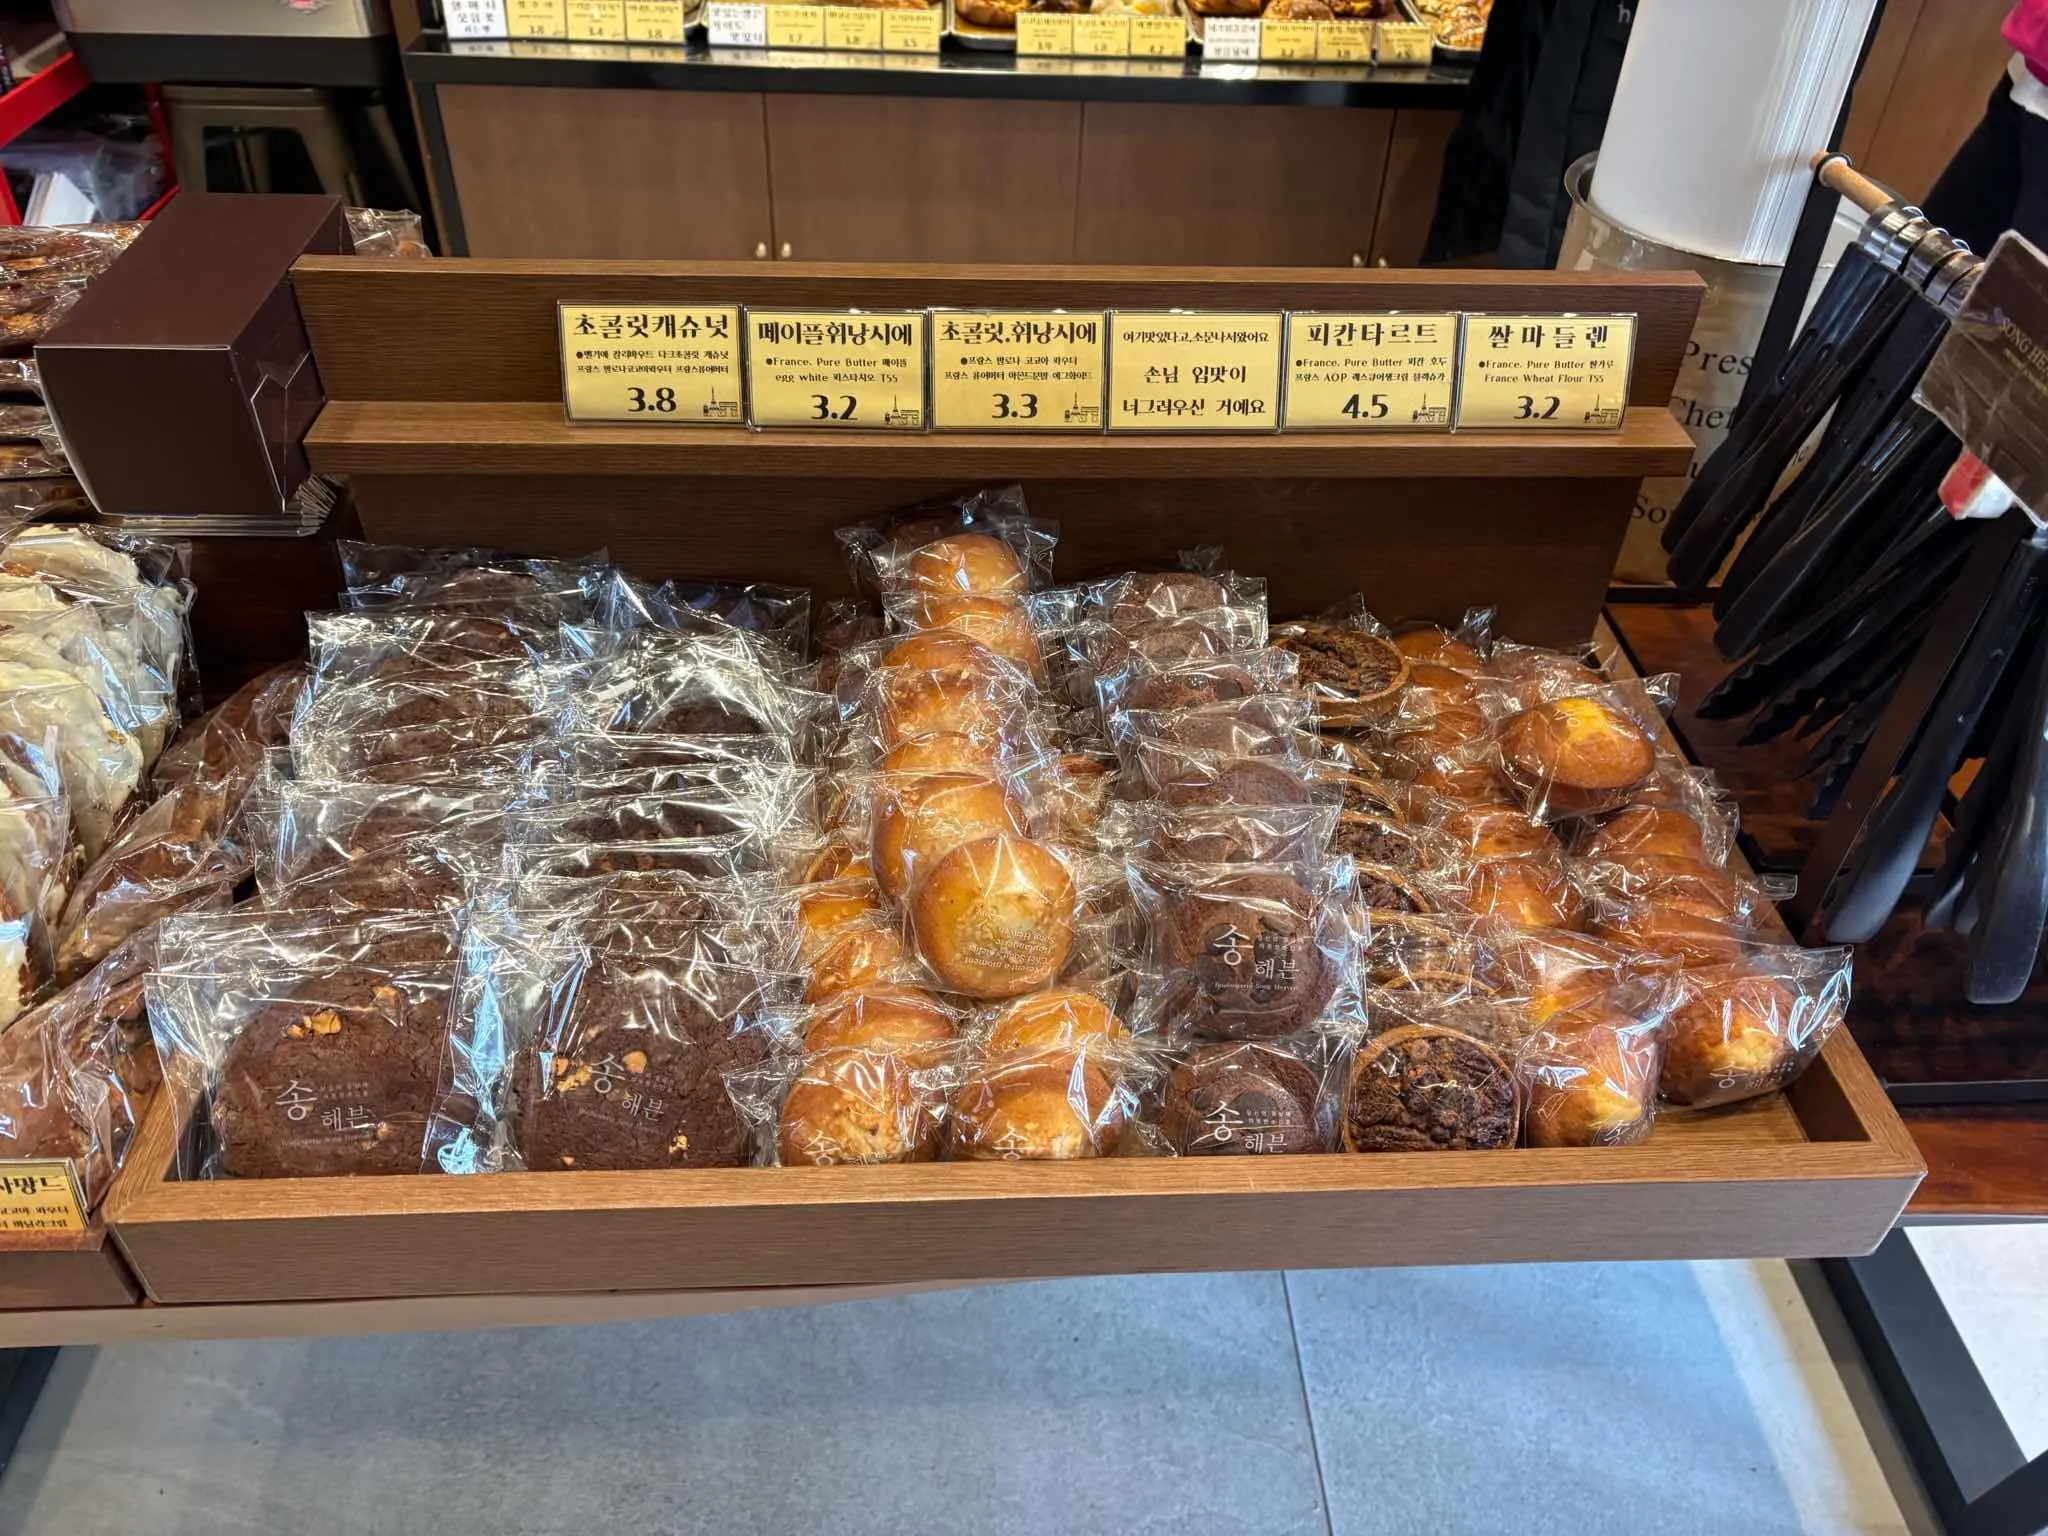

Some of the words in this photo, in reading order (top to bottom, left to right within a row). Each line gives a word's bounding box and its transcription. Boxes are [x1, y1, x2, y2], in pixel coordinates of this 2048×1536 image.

[573, 313, 729, 339] 초콜릿캐슈넛
[757, 321, 913, 346] 메이플휘낭시에
[939, 320, 1097, 345] 초콜릿.휘낭시에
[1307, 322, 1438, 347] 피칸타르트
[816, 357, 841, 367] Pure
[845, 357, 878, 367] Butter
[1024, 356, 1049, 365] 코코아
[1344, 358, 1368, 367] Pure
[1372, 357, 1403, 367] Butter
[1526, 360, 1550, 369] Pure
[1553, 359, 1585, 369] Butter
[775, 373, 795, 382] egg
[799, 372, 829, 382] white
[1143, 365, 1179, 384] 손님
[1191, 365, 1247, 384] 입맛이
[1323, 372, 1348, 383] AOP
[1484, 374, 1519, 383] France
[1523, 374, 1554, 383] Wheat
[1557, 374, 1585, 383] Flour
[627, 386, 677, 413] 3.8
[811, 393, 858, 421] 3.2
[991, 393, 1039, 419] 3.3
[1122, 398, 1205, 416] 너그러우신
[1215, 398, 1266, 415] 거예요
[1341, 393, 1389, 419] 4.5
[1513, 395, 1561, 420] 3.2
[1213, 924, 1254, 966] 송
[589, 1052, 626, 1094] 송
[274, 1079, 318, 1121] 송
[1203, 1100, 1244, 1141] 송
[1244, 1132, 1288, 1154] 해븐
